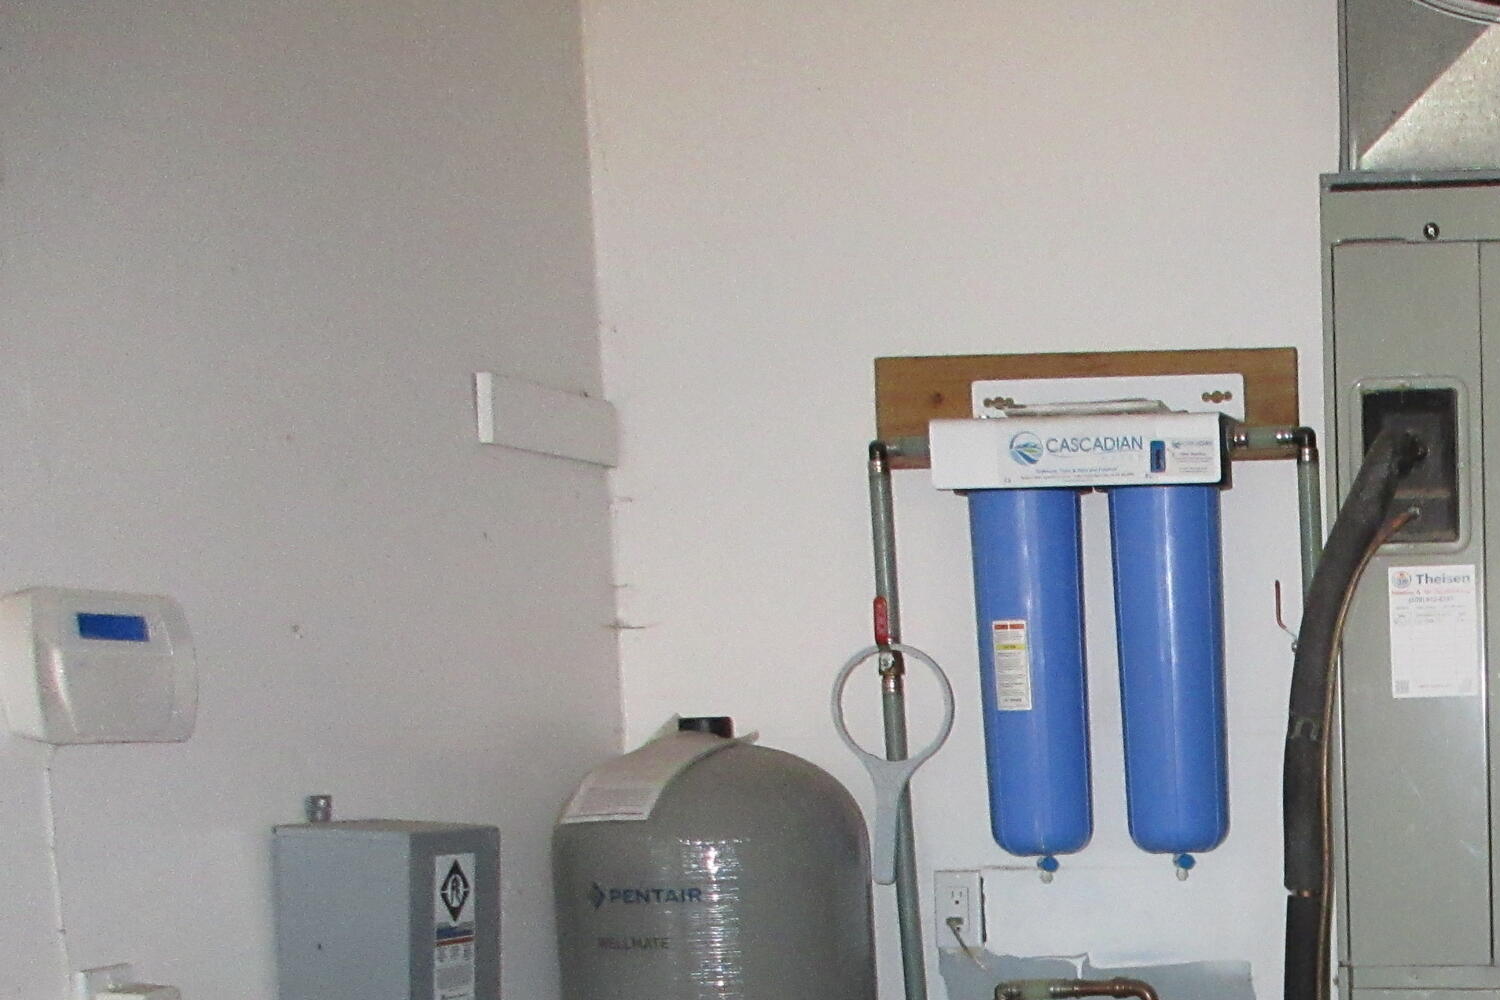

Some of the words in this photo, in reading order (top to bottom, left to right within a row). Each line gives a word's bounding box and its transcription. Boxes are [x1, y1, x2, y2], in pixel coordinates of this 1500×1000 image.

[1046, 436, 1143, 453] CASCADIAN
[1416, 573, 1471, 585] Theisen
[610, 887, 702, 903] PENTAIR
